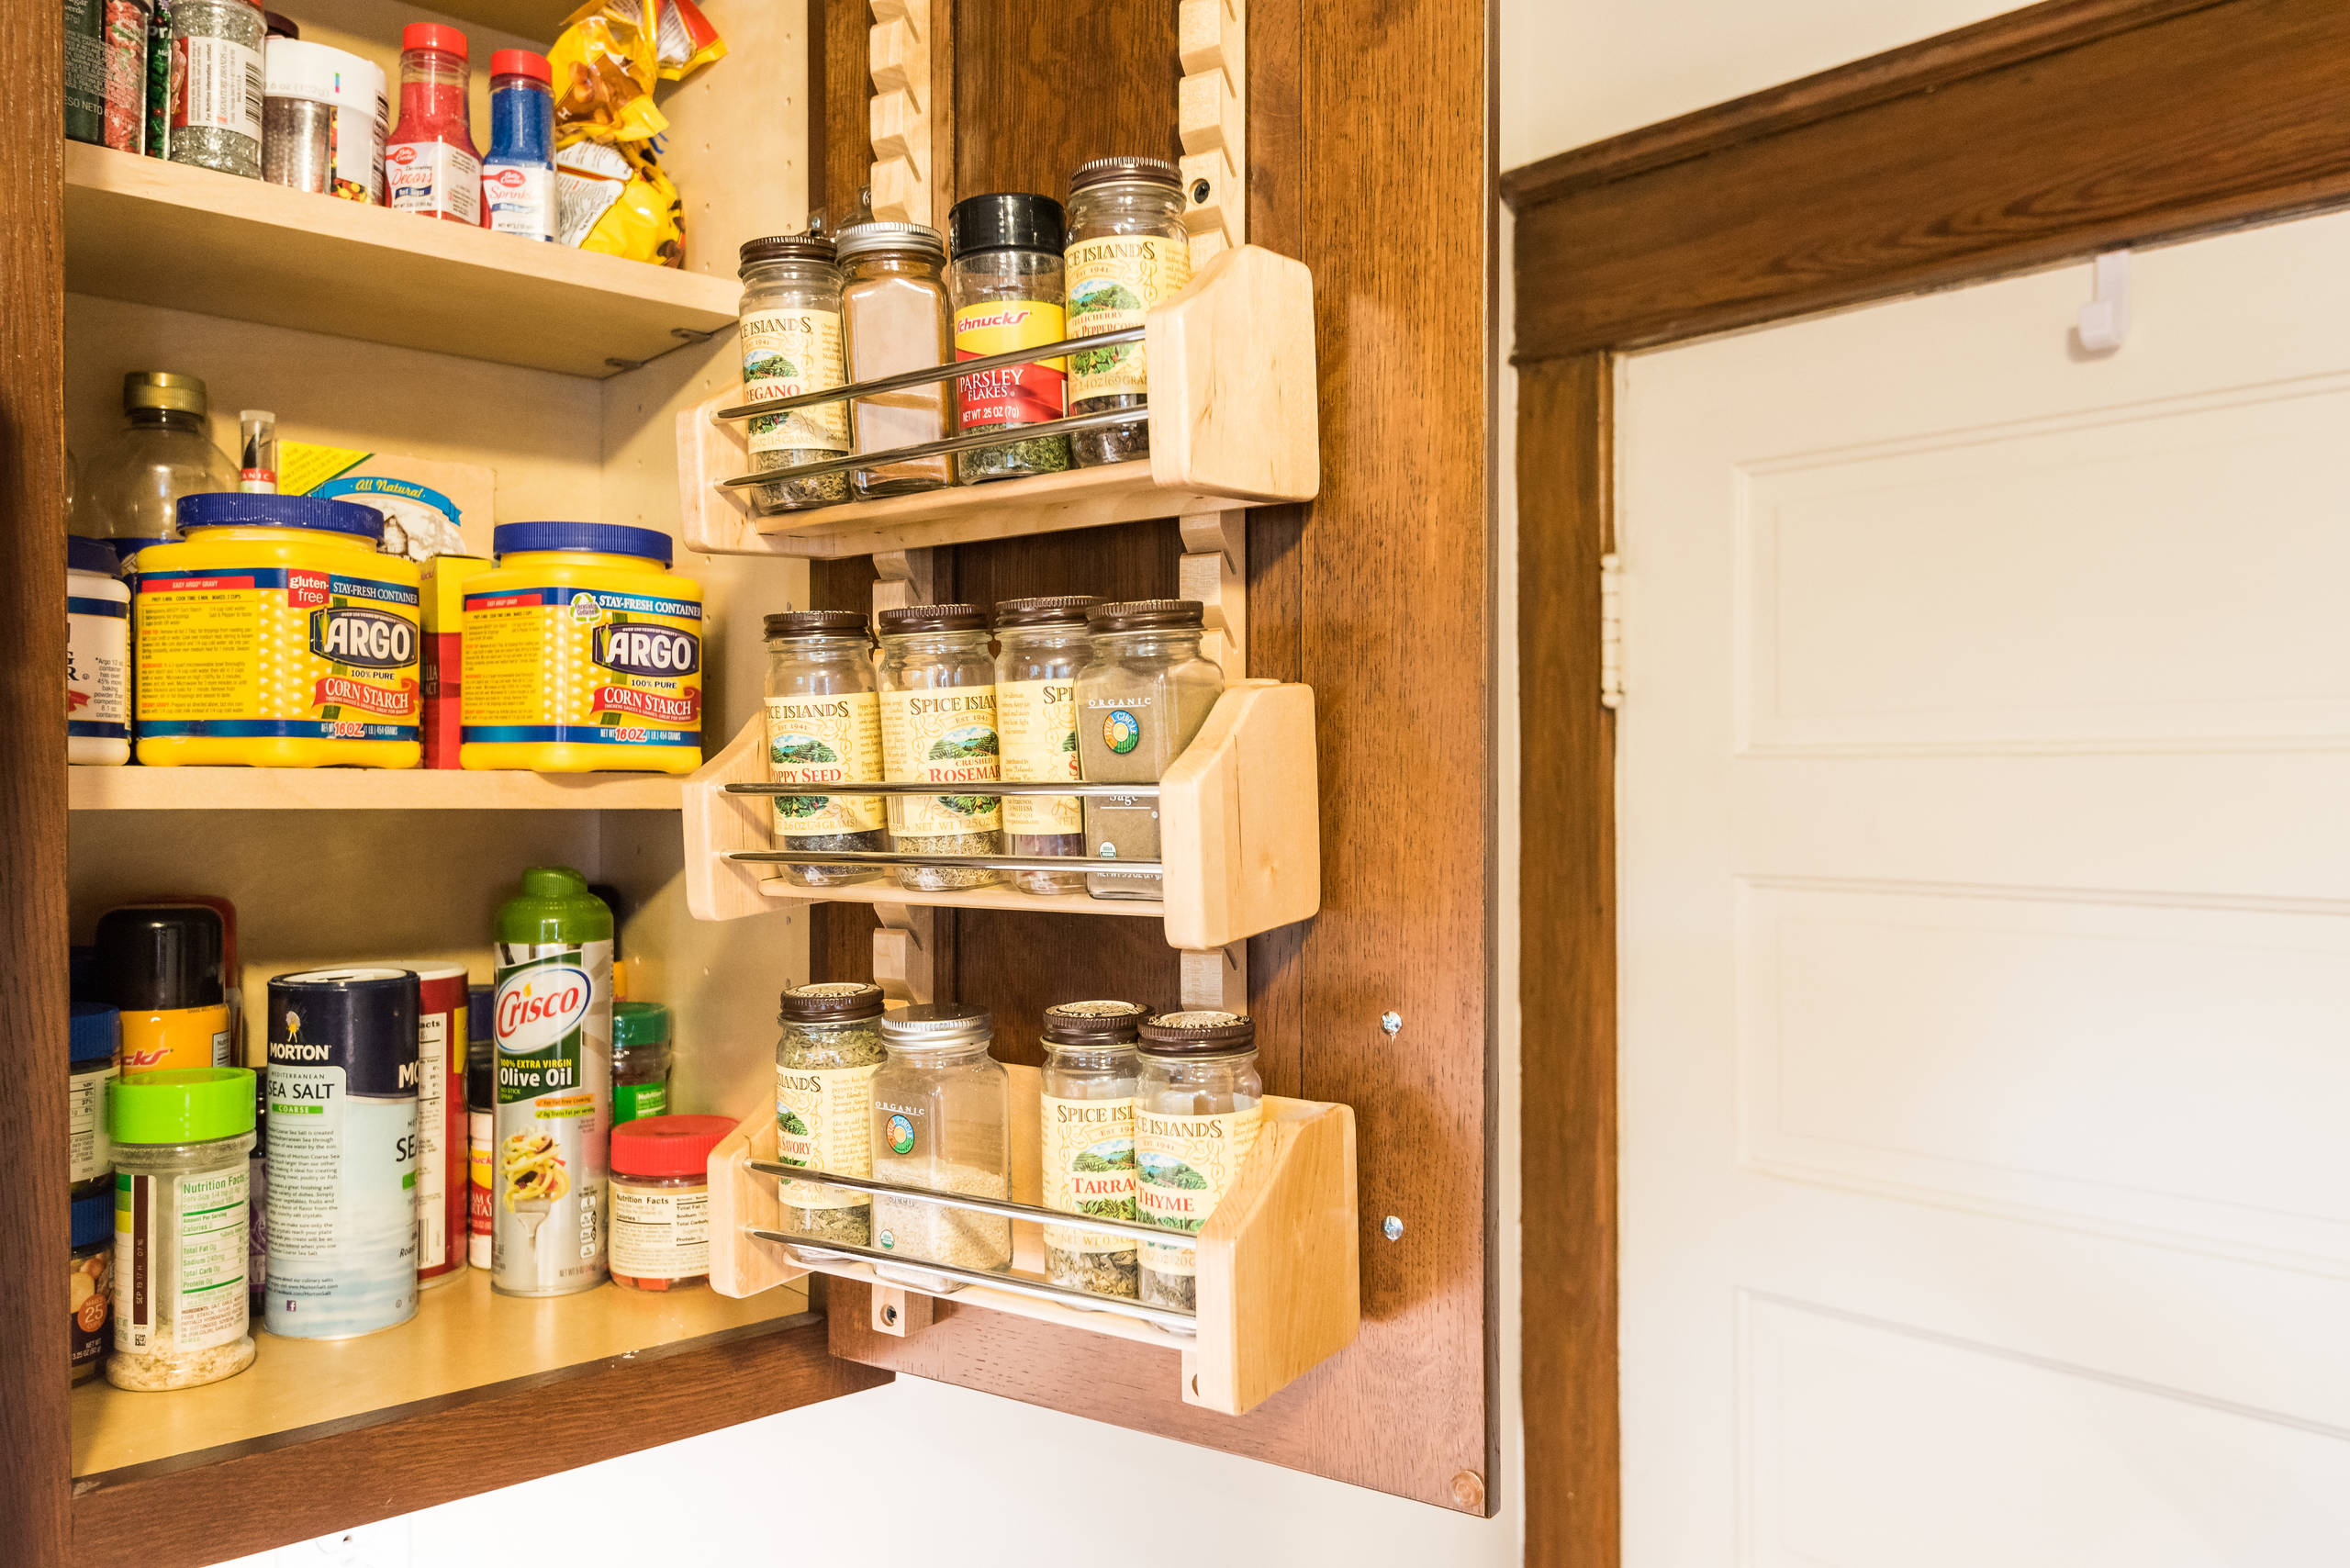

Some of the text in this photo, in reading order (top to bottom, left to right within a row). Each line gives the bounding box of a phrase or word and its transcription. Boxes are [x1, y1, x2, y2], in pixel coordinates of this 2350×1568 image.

[1083, 241, 1155, 263] ISLANDS
[750, 316, 812, 335] ISLANDS
[960, 369, 1024, 394] PARSLEY
[968, 386, 1008, 402] FLAKES
[963, 409, 972, 422] NET
[971, 408, 981, 420] WT
[993, 406, 1004, 418] OZ
[1004, 405, 1020, 420] (7g)
[355, 480, 424, 498] All Natural
[289, 575, 330, 589] gluten-
[297, 588, 324, 603] free
[333, 581, 419, 605] STAY-FRESH CONTAINER
[599, 595, 654, 612] STAY-FRESH
[324, 617, 411, 662] ARGO
[605, 632, 691, 670] ARGO
[351, 669, 395, 680] 100% PURE
[631, 678, 652, 688] 100%
[325, 678, 408, 710] CORN STARCH
[604, 687, 691, 716] CORN STARCH
[1043, 686, 1074, 705] SPI
[1088, 698, 1152, 707] ORGANIC
[783, 700, 849, 720] ISLANDS
[910, 698, 962, 716] SPICE
[334, 722, 346, 735] 16
[1117, 712, 1137, 735] CIRCLE
[615, 728, 629, 741] 16
[667, 733, 681, 741] GRAMS
[955, 758, 993, 767] CRUSHED
[801, 767, 842, 783] SEED
[498, 983, 579, 1038] Crisco
[270, 1042, 330, 1061] MORTON
[500, 1058, 572, 1069] 100% EXTRA VIRGIN
[271, 1070, 325, 1080] MEDITERRANEAN
[500, 1067, 573, 1087] Olive Oil
[268, 1080, 335, 1100] SEA SALT
[573, 1096, 591, 1104] Cooking
[875, 1101, 925, 1115] ORGANIC
[278, 1105, 310, 1114] COARSE
[1057, 1104, 1108, 1124] SPICE
[1149, 1118, 1223, 1138] ISLANDS
[782, 1136, 811, 1155] SAVORY
[184, 1173, 245, 1194] Nutrition Facts
[617, 1193, 669, 1204] Nutrition Facts
[1138, 1187, 1195, 1213] THYME
[184, 1224, 207, 1233] Calories
[184, 1245, 208, 1255] Total Fat
[184, 1258, 206, 1266] Sodium
[184, 1267, 213, 1277] Total Carb
[84, 1303, 104, 1324] 25
